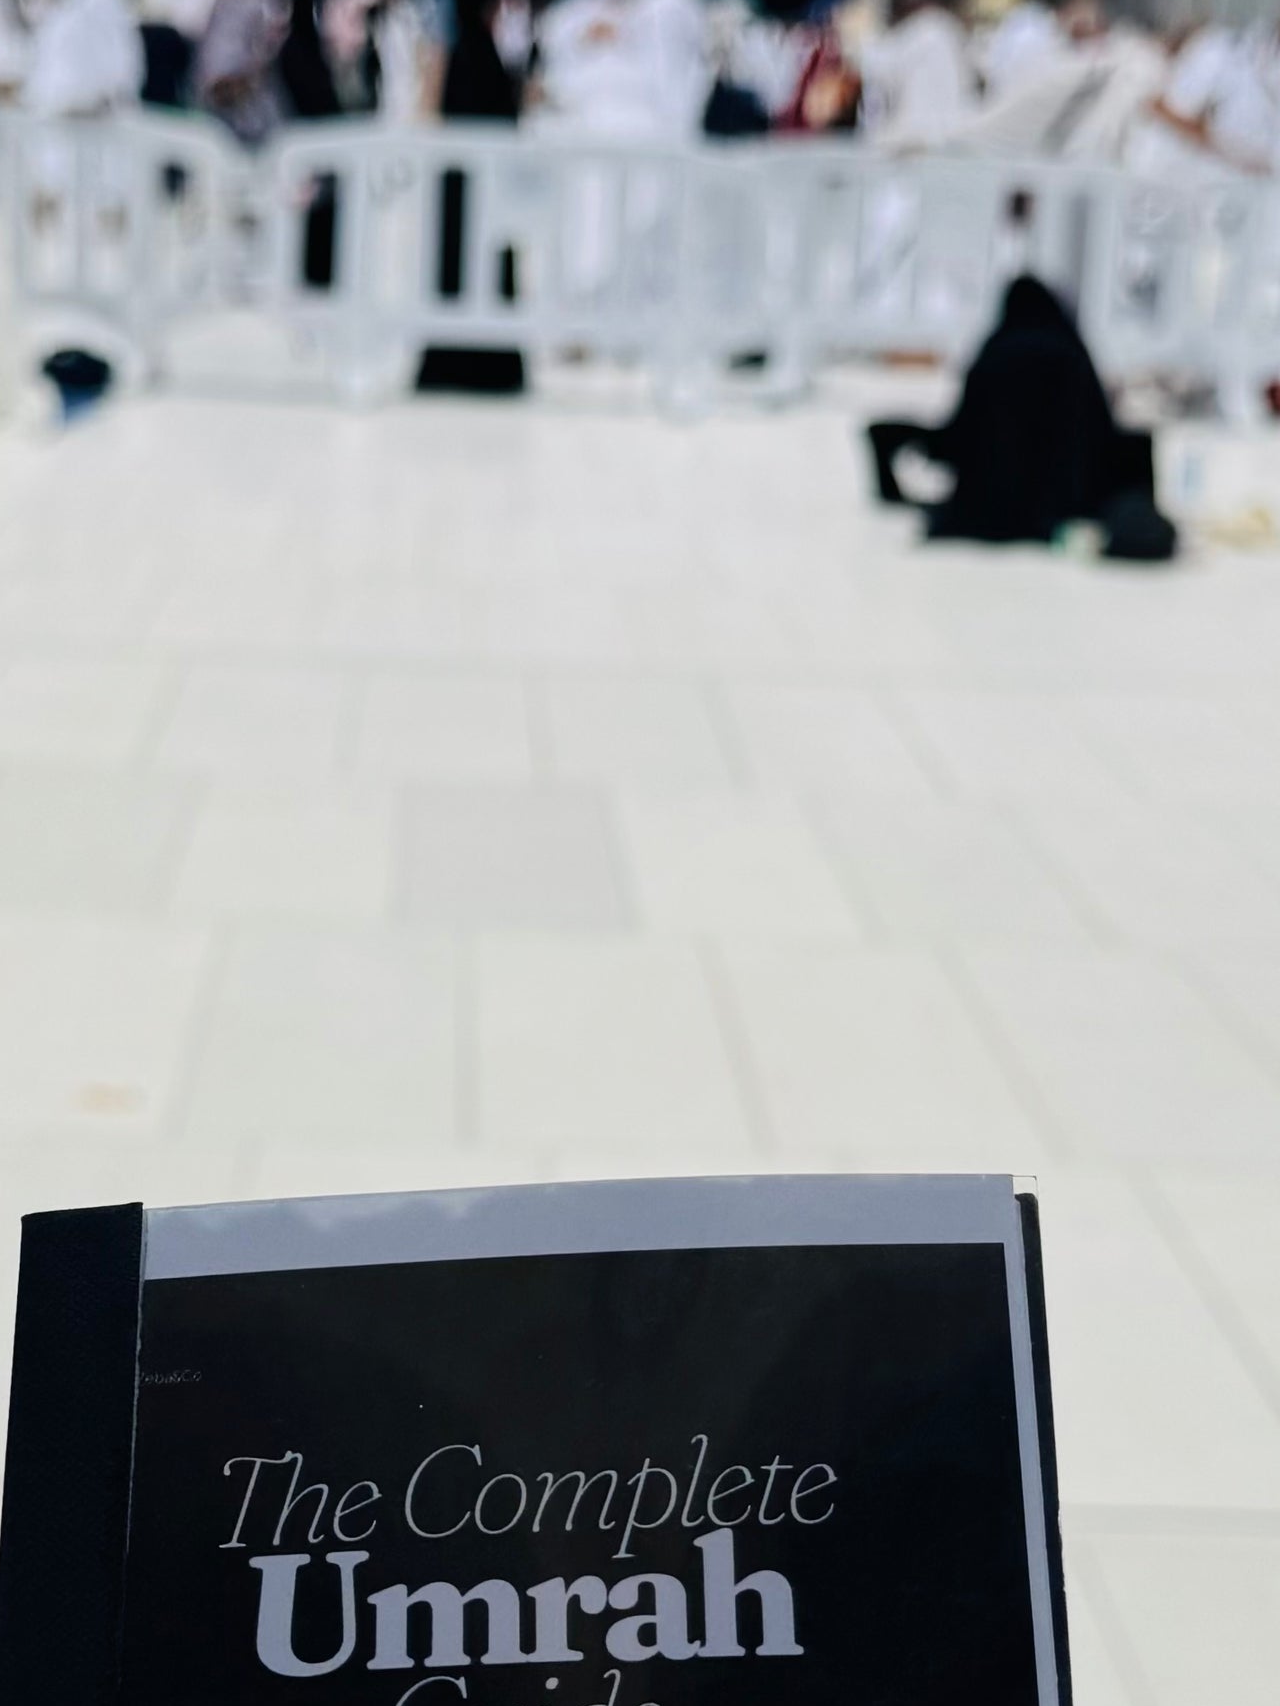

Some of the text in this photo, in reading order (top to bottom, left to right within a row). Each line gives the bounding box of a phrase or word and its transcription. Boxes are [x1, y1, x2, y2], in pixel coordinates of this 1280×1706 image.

[219, 1435, 839, 1558] The Complete
[248, 1528, 805, 1678] Umrah
